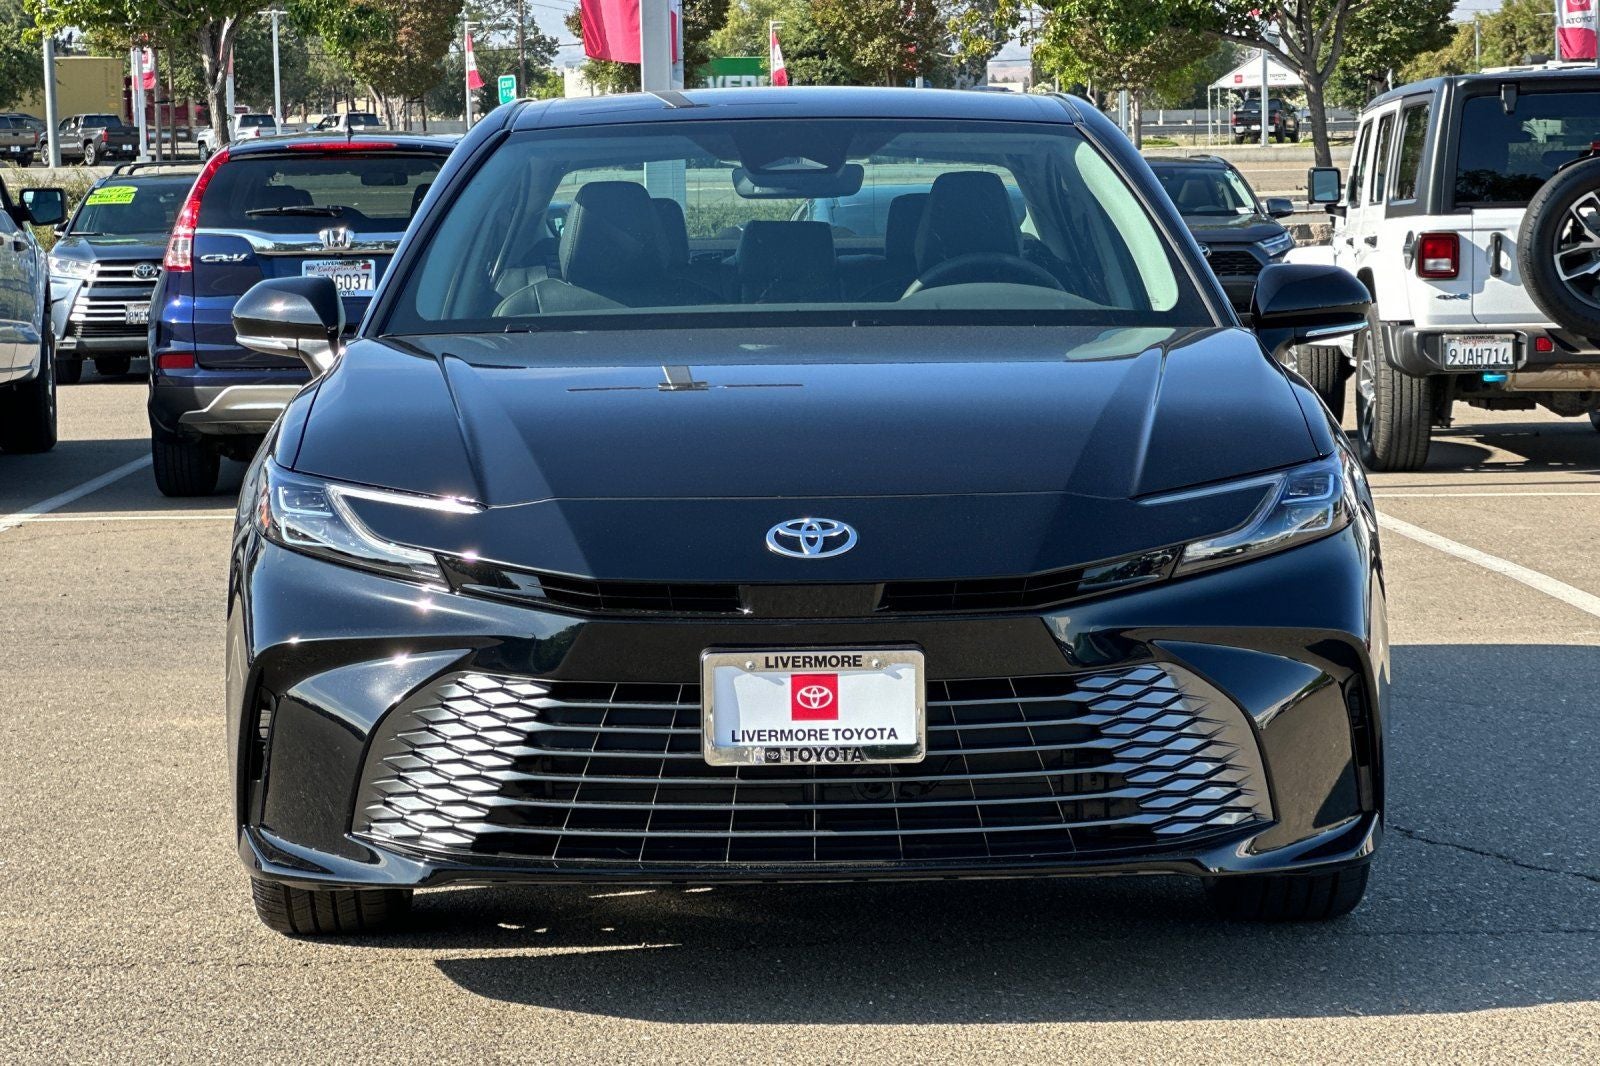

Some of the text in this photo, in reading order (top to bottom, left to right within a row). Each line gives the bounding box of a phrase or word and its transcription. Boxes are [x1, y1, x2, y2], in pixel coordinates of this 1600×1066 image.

[200, 253, 248, 263] CR-V
[1449, 347, 1509, 364] 9JAH714
[764, 655, 863, 669] LIVERMORE
[731, 728, 898, 743] LIVERMORE TOYOTA
[785, 747, 865, 763] TOYOTA
